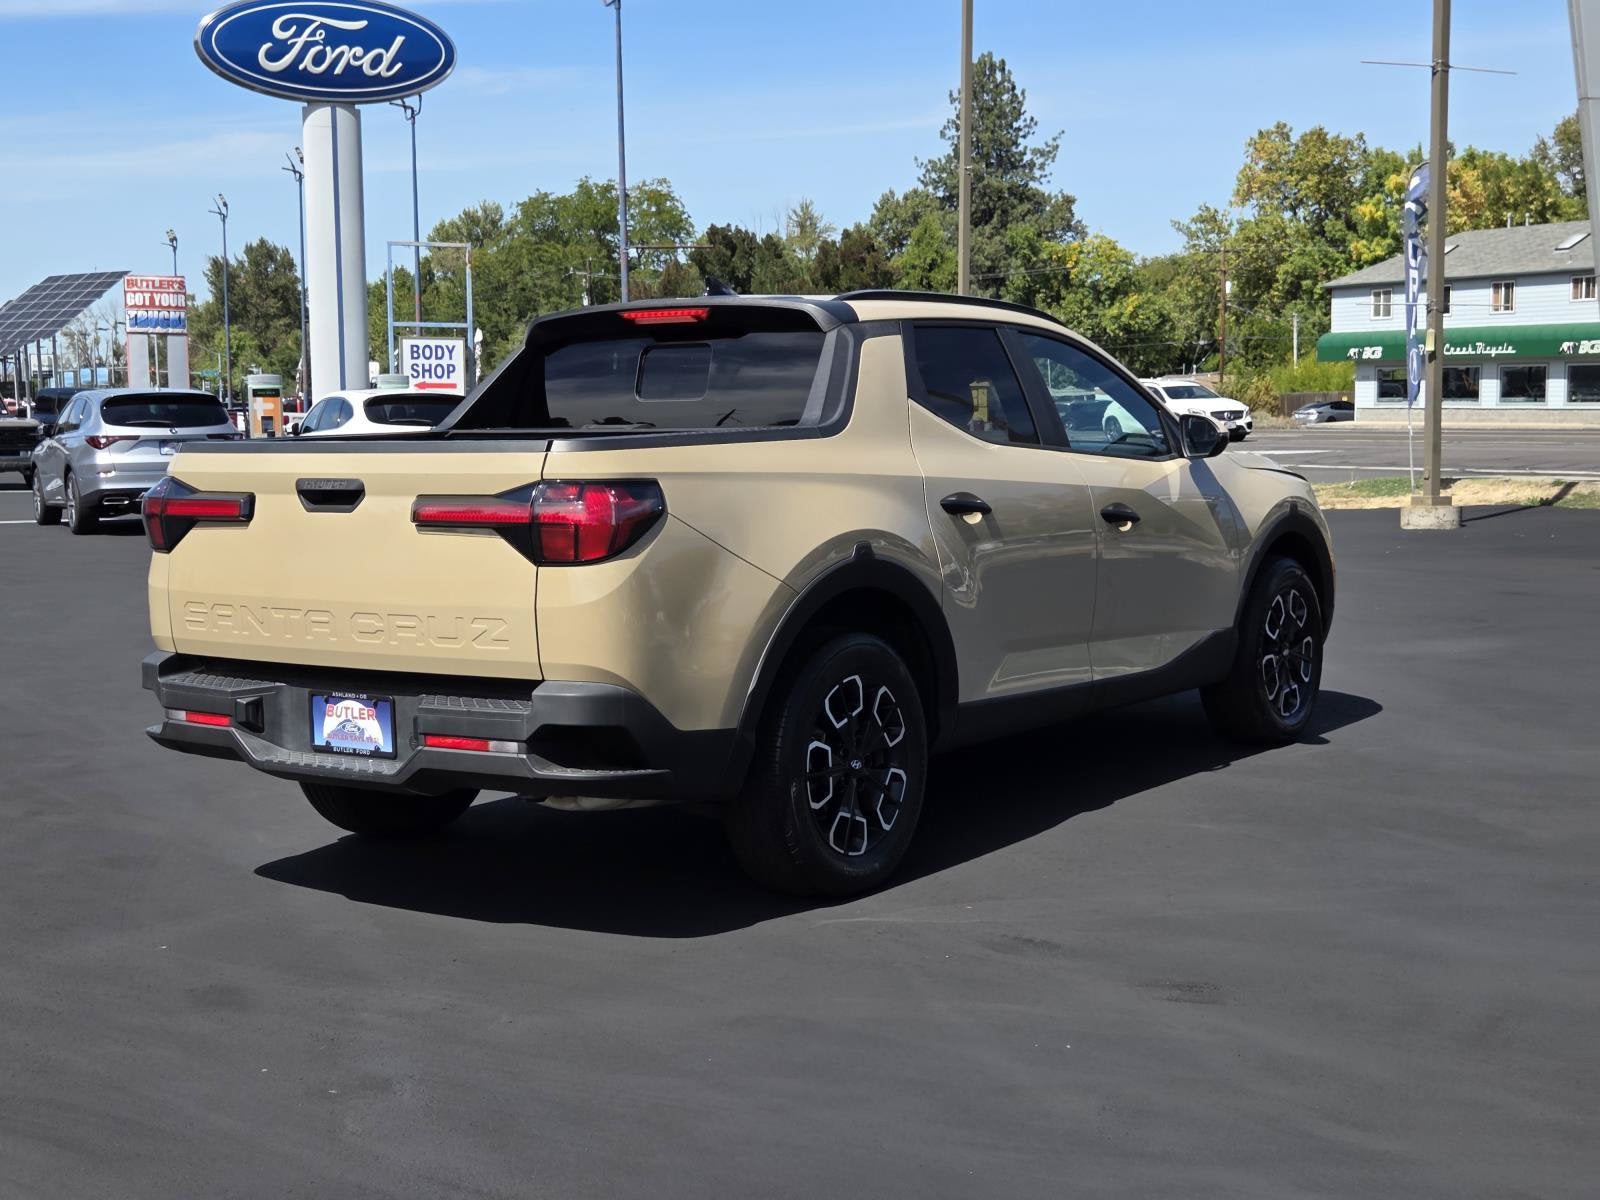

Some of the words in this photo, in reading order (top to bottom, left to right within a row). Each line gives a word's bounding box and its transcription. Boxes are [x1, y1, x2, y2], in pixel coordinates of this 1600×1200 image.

[258, 13, 405, 78] Ford
[126, 278, 185, 289] BUTLER'S
[126, 292, 151, 306] GOT
[154, 292, 185, 307] YOUR
[410, 344, 456, 360] BODY
[410, 363, 456, 379] SHOP
[184, 601, 339, 641] SANTA
[350, 612, 510, 650] CRUZ
[327, 703, 375, 720] BUTLER
